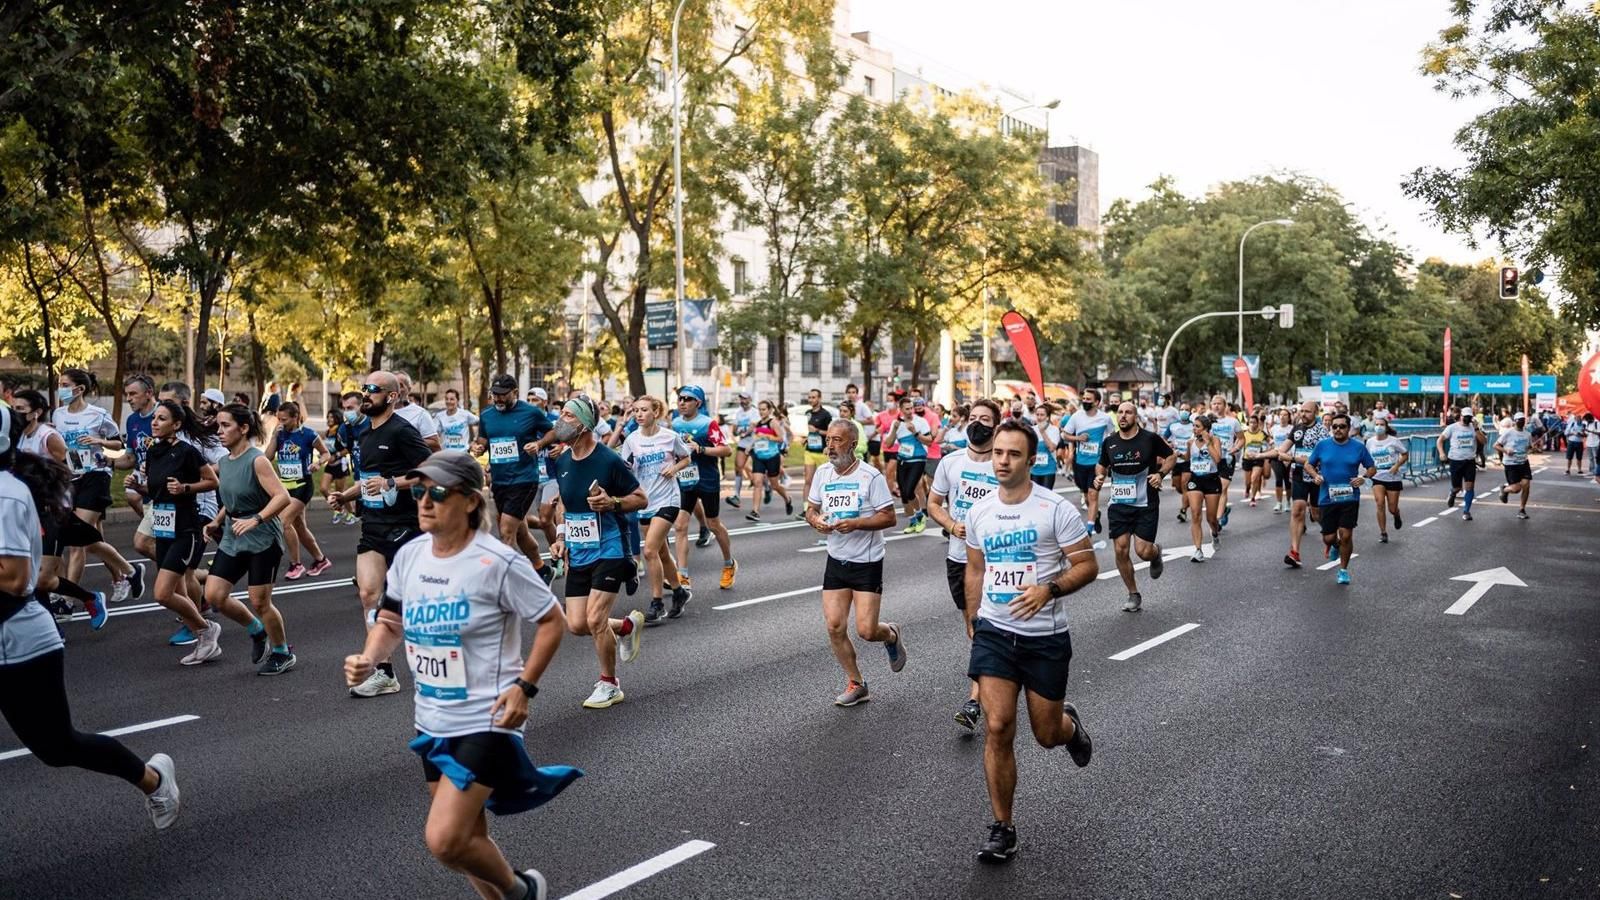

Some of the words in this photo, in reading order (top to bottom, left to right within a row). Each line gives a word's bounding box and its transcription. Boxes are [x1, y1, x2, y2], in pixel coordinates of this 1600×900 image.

[494, 446, 513, 455] 4395
[281, 467, 298, 475] 2238
[965, 486, 992, 499] 489
[1114, 488, 1131, 496] 2510
[828, 495, 851, 508] 2673
[569, 526, 590, 538] 2315
[984, 529, 1038, 553] MADRID
[994, 571, 1025, 586] 2417
[405, 600, 470, 625] MADRID
[416, 654, 448, 678] 2701
